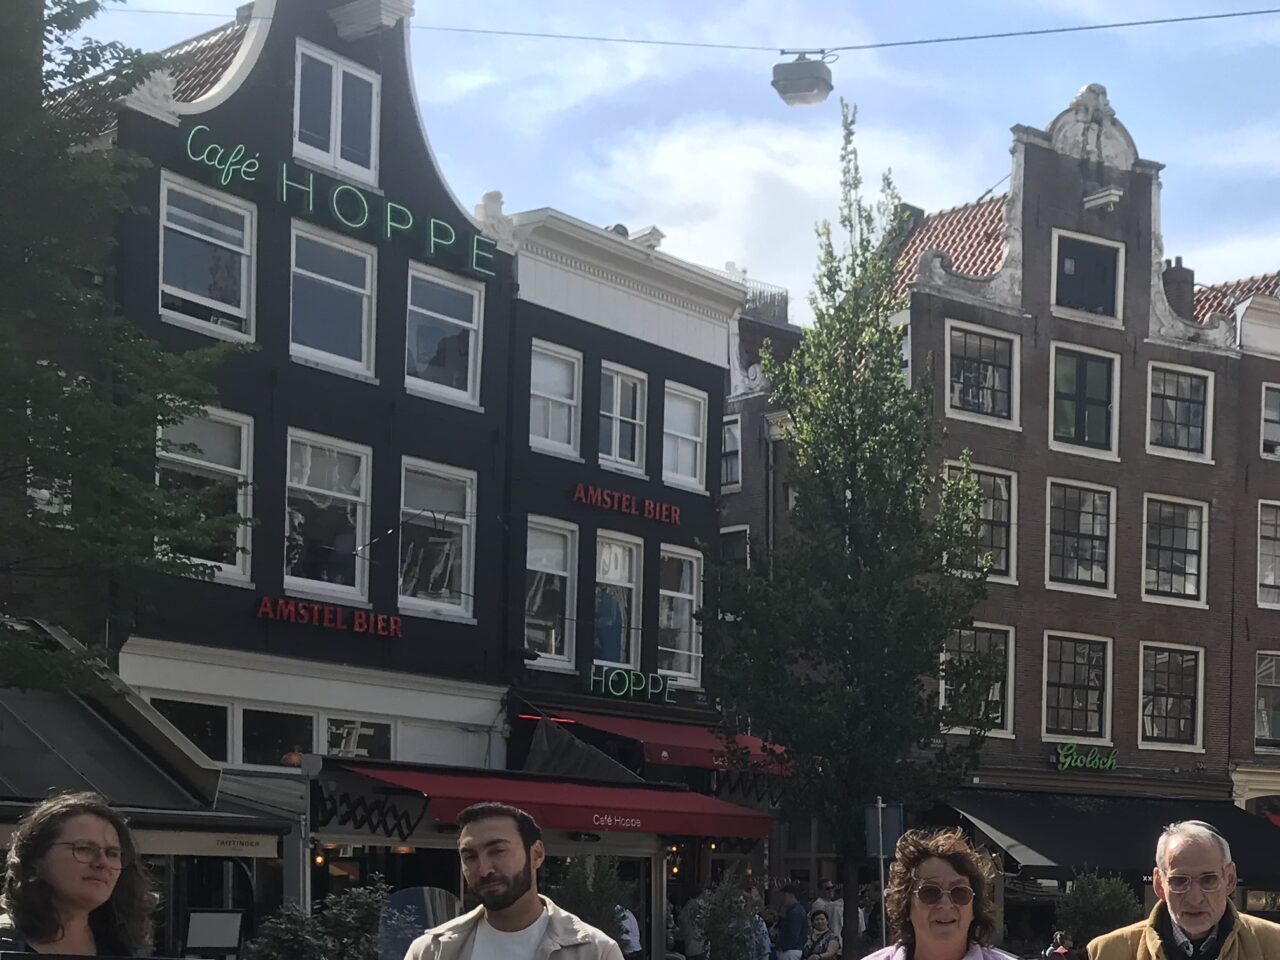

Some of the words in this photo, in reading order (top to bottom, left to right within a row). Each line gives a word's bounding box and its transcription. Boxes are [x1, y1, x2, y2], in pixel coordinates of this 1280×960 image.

[187, 125, 260, 185] Café
[282, 162, 497, 276] HOPPE
[574, 483, 639, 515] AMSTEL
[643, 499, 681, 524] BIER
[257, 596, 348, 629] AMSTEL
[353, 610, 402, 637] BIER
[590, 665, 677, 703] HOPPE
[1057, 743, 1120, 771] Grolsch
[592, 814, 612, 826] Café
[614, 816, 641, 828] Hoppe
